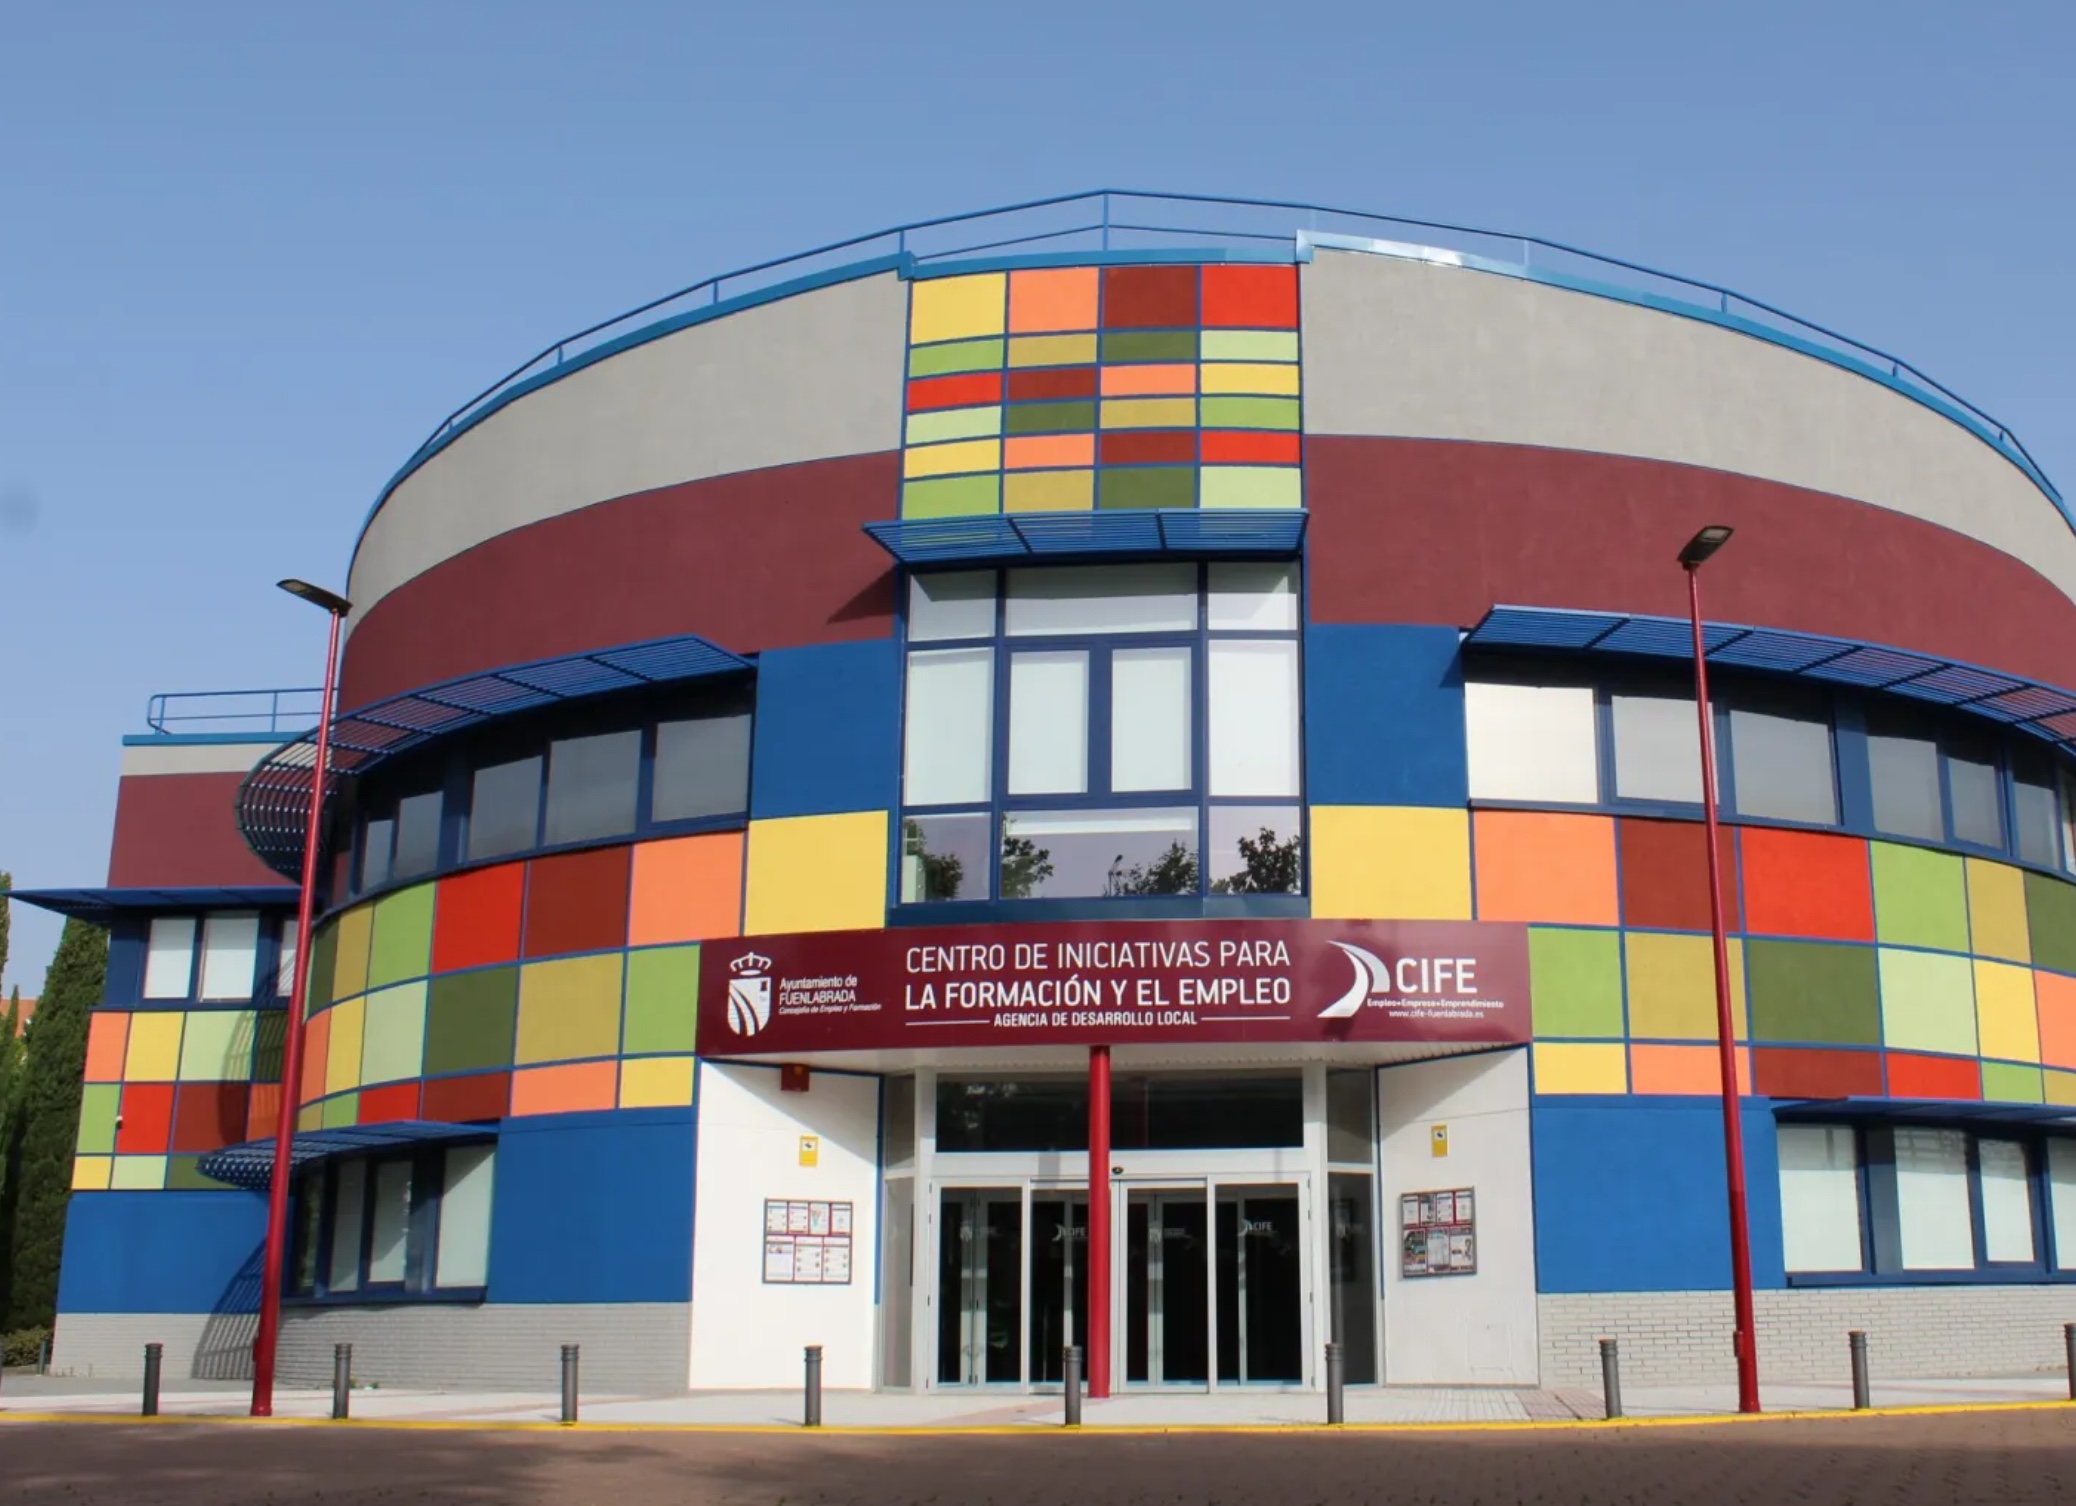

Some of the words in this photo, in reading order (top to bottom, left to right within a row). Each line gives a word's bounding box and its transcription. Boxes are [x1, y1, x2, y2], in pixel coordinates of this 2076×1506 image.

[906, 944, 1005, 973] CENTRO
[1014, 943, 1048, 970] DE
[1057, 941, 1211, 969] INICIATIVAS
[1220, 940, 1291, 967] PARA
[780, 977, 843, 993] Ayuntamiento
[845, 975, 858, 987] de
[1396, 957, 1478, 994] CIFE
[780, 989, 856, 1005] FUENLABRADA
[905, 983, 937, 1011] LA
[945, 973, 1101, 1009] FORMACIÓN
[1110, 979, 1128, 1006] Y
[1136, 979, 1170, 1006] EL
[1178, 977, 1291, 1005] EMPLEO
[994, 1012, 1048, 1027] AGENCIA
[1052, 1012, 1068, 1027] DE
[1071, 1011, 1153, 1026] DESARROLLO
[1157, 1011, 1198, 1026] LOCAL
